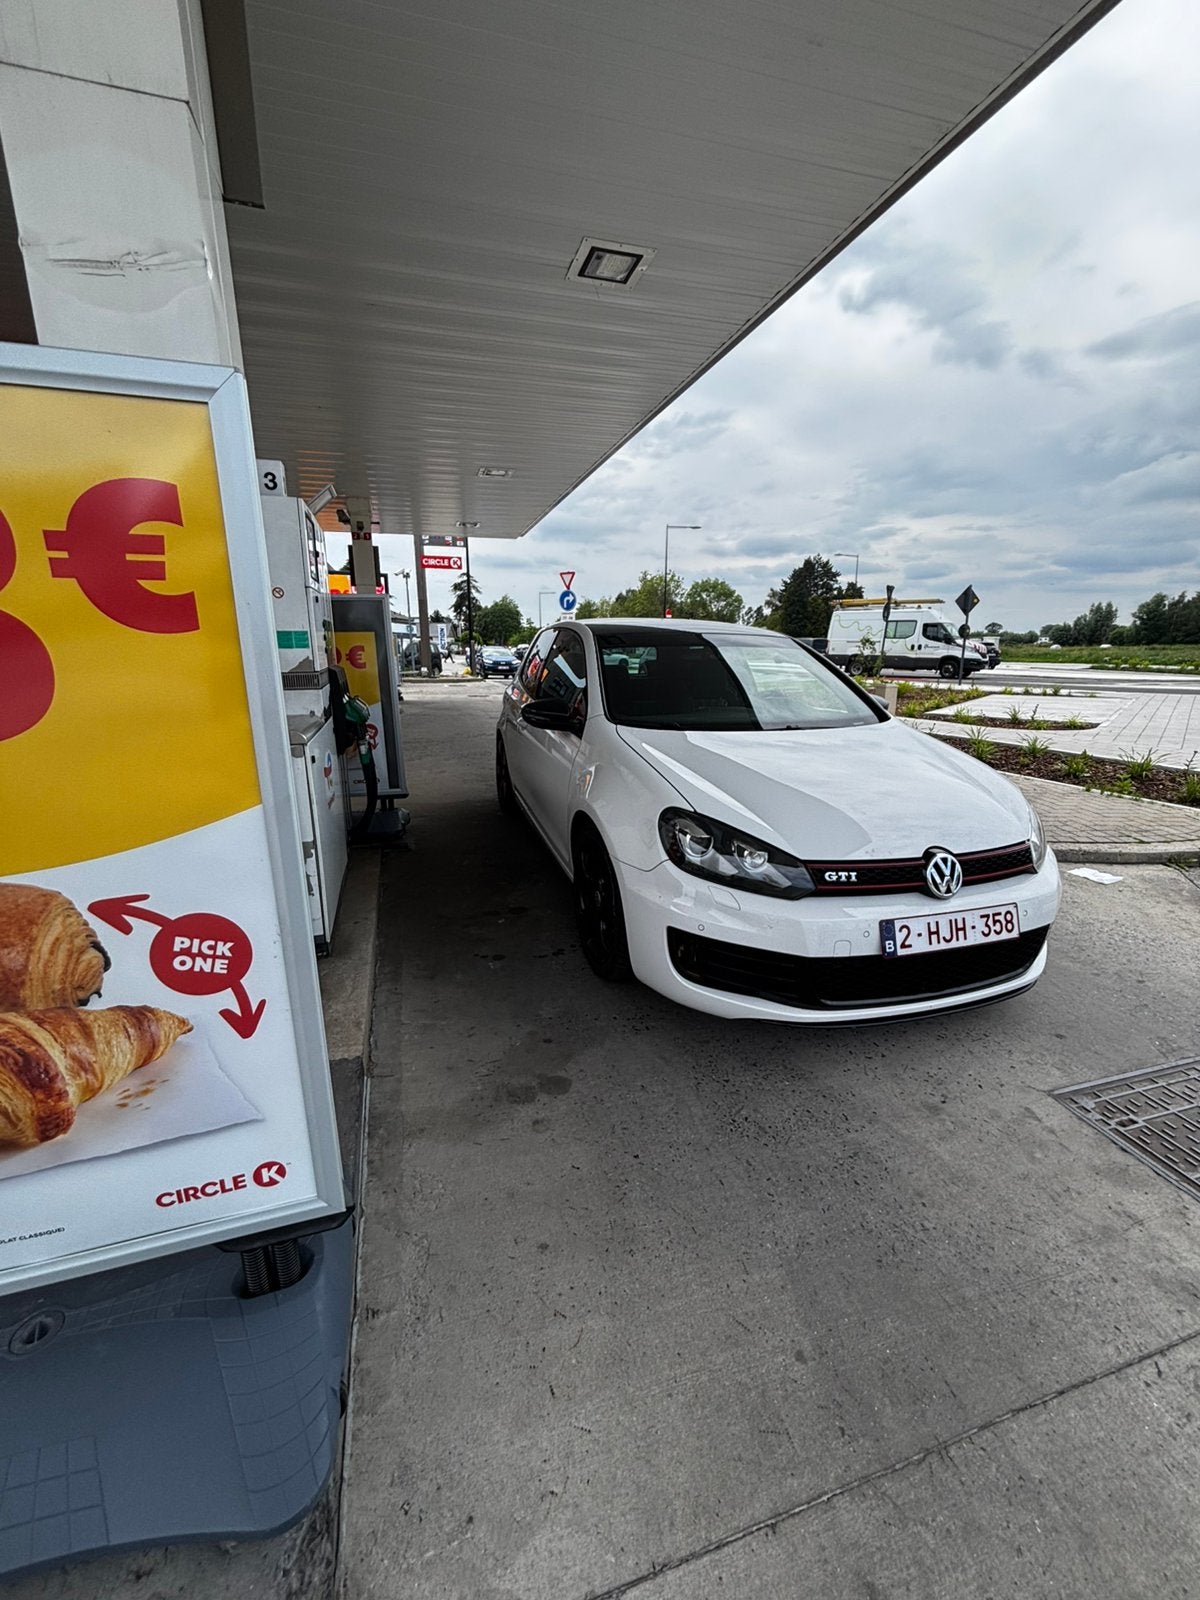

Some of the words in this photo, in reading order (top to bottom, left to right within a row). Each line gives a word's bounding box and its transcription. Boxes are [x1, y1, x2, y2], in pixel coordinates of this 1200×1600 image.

[263, 472, 278, 491] 3
[422, 557, 449, 566] CIRCLE
[451, 558, 461, 568] K
[824, 871, 858, 882] GTI
[173, 936, 234, 957] PICK
[885, 940, 895, 952] B
[172, 955, 229, 974] ONE
[155, 1173, 248, 1208] CIRCLE
[256, 1162, 286, 1186] K
[19, 1227, 66, 1241] CLASSIQUE)
